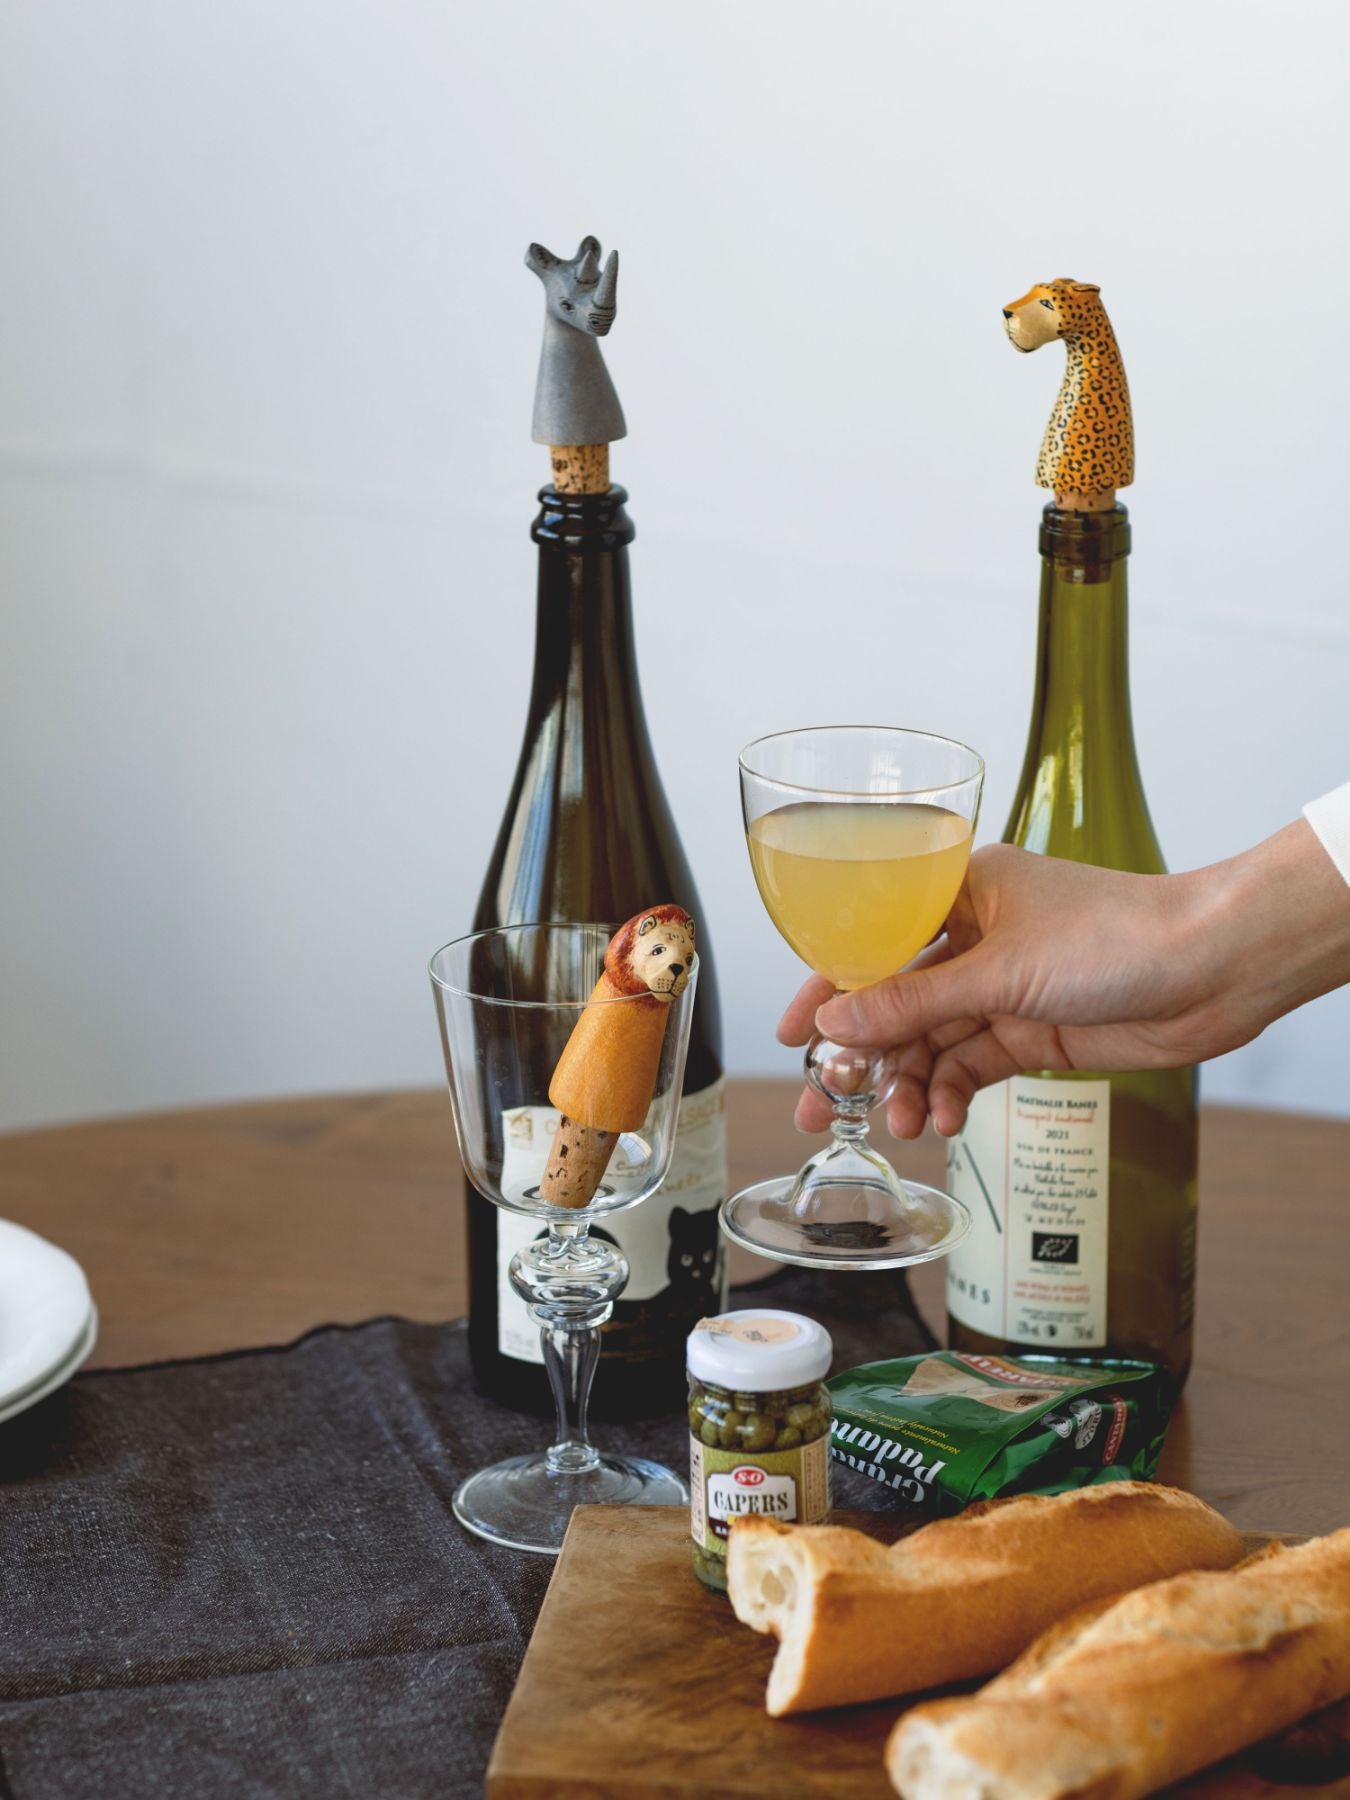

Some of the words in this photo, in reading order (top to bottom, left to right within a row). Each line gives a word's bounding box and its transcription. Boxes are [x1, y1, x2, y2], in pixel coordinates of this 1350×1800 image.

[1046, 1130, 1069, 1140] 2021
[1055, 1148, 1093, 1156] FRANCE
[714, 1490, 788, 1514] CAPERS
